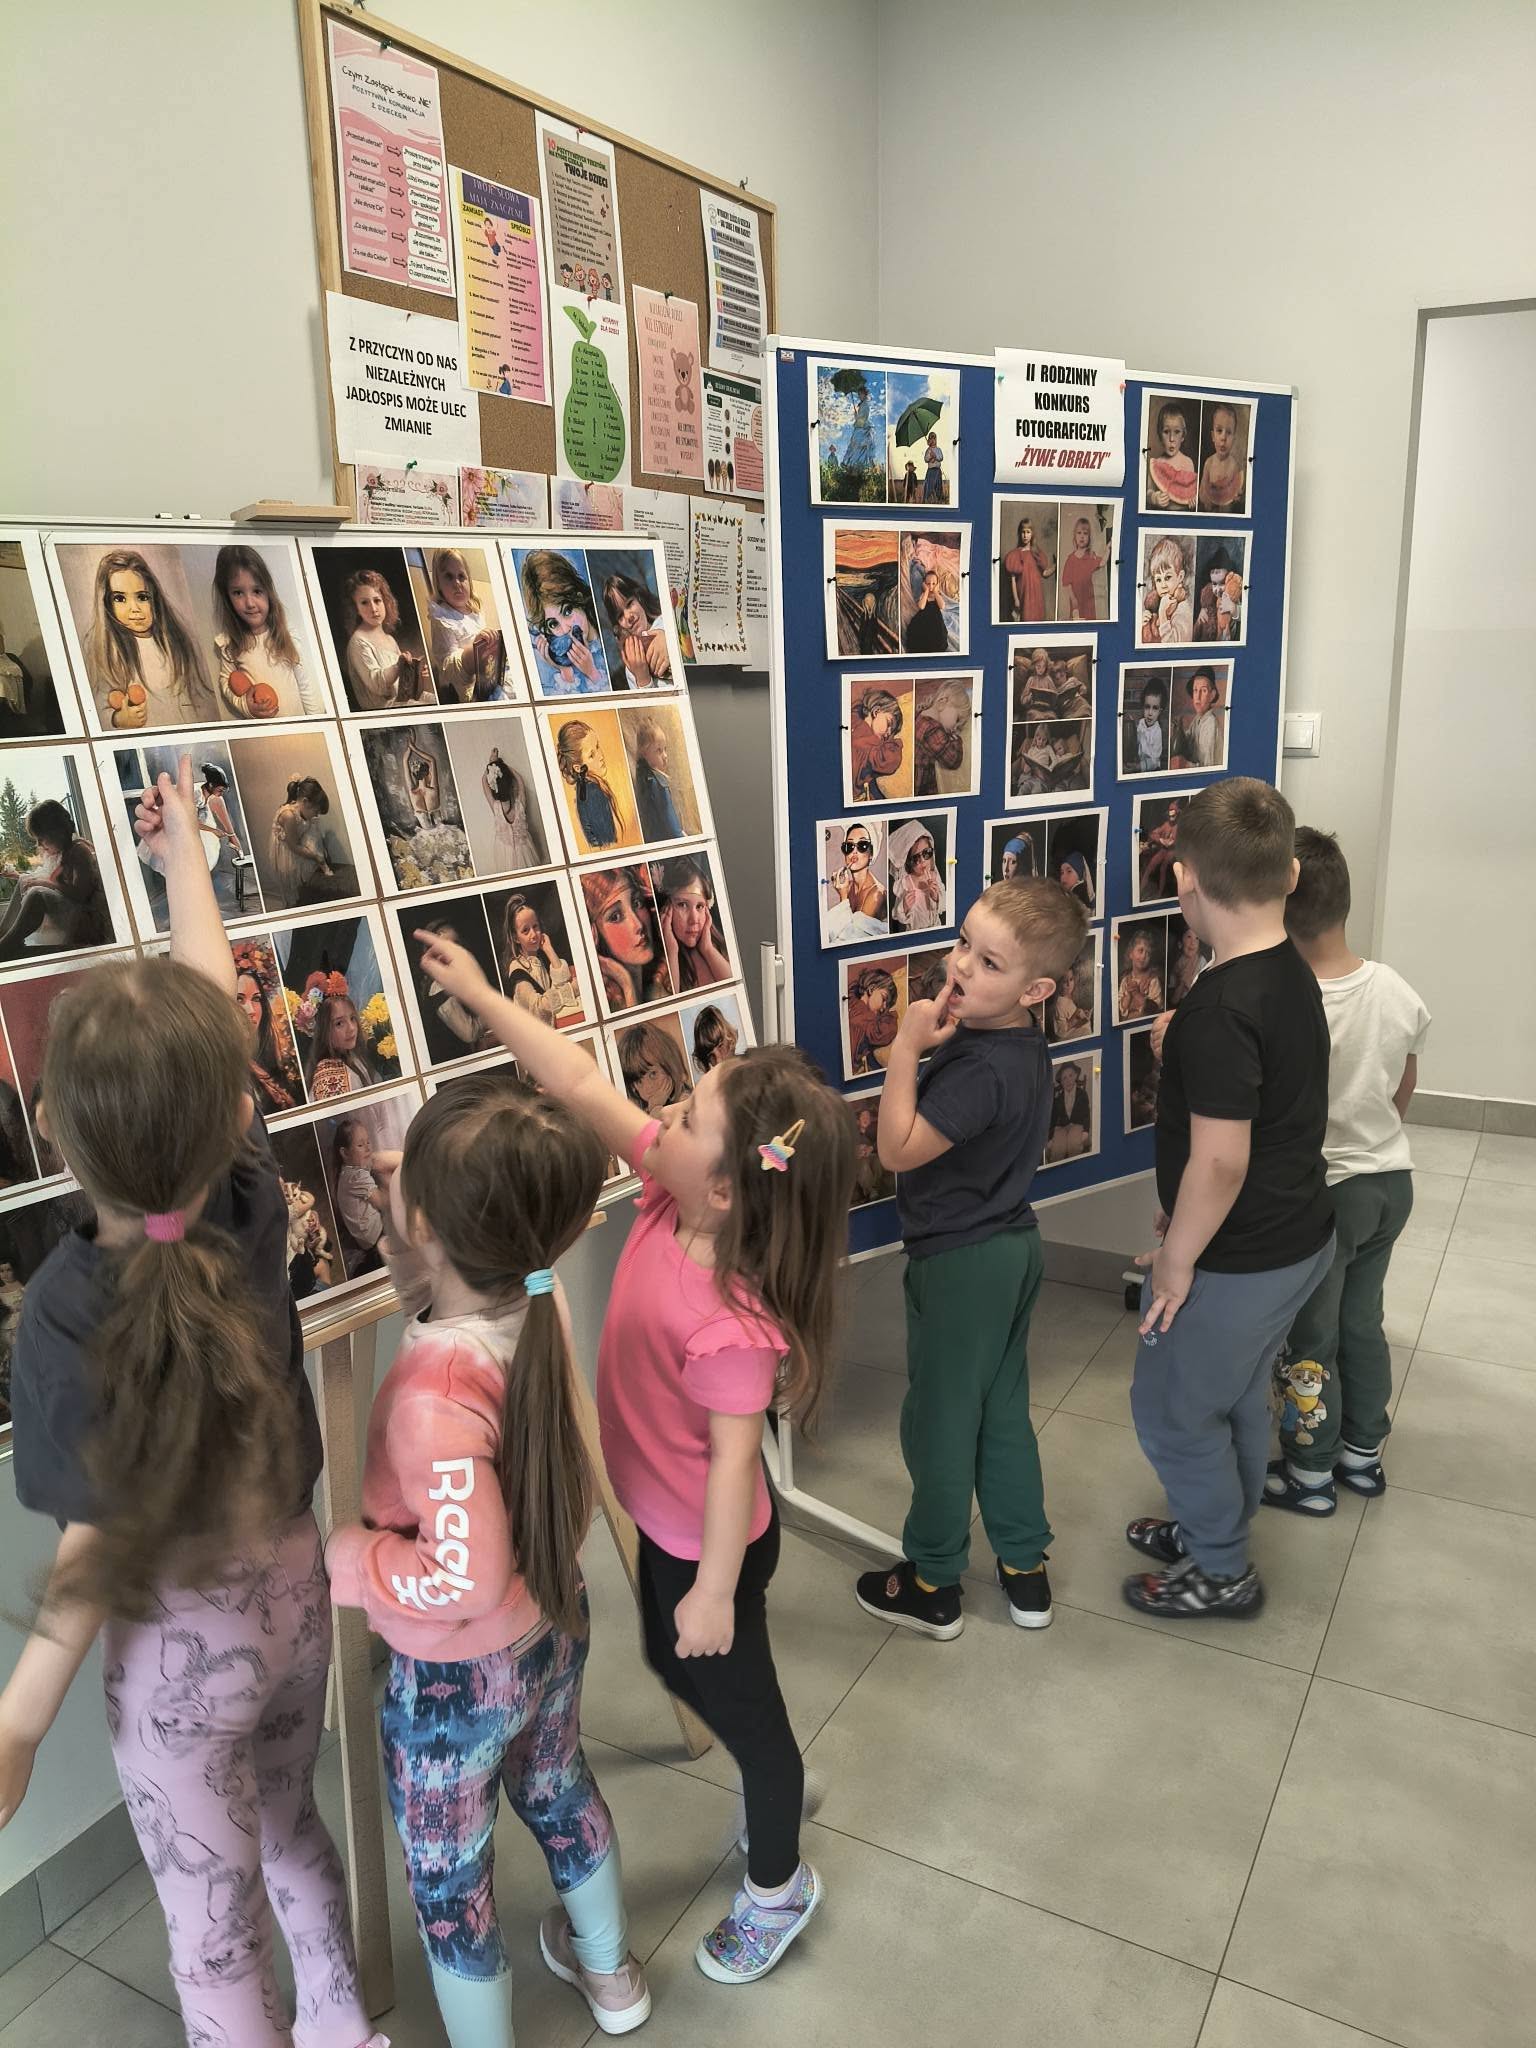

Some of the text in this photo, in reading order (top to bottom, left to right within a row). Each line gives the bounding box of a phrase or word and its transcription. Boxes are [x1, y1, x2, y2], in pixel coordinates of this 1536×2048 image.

[341, 65, 363, 83] Czym
[547, 137, 556, 150] 10
[564, 162, 608, 188] TWOJE DZIECI
[473, 178, 494, 195] TWOJE
[462, 204, 484, 217] ZAMIAST
[510, 221, 531, 235] SPRÓBUJ
[349, 336, 458, 371] Z PRZYCZYN OD NAS
[365, 364, 446, 392] NIEZALEŻNYCH
[1026, 363, 1098, 387] II RODZINNY
[345, 385, 467, 418] JADŁOSPIS MOŻE ULEC
[1034, 392, 1090, 414] KONKURS
[384, 416, 433, 436] ZMIANIE
[1015, 418, 1107, 441] FOTOGRAFICZNY
[1015, 444, 1111, 470] „ŻYWE OBRAZY”
